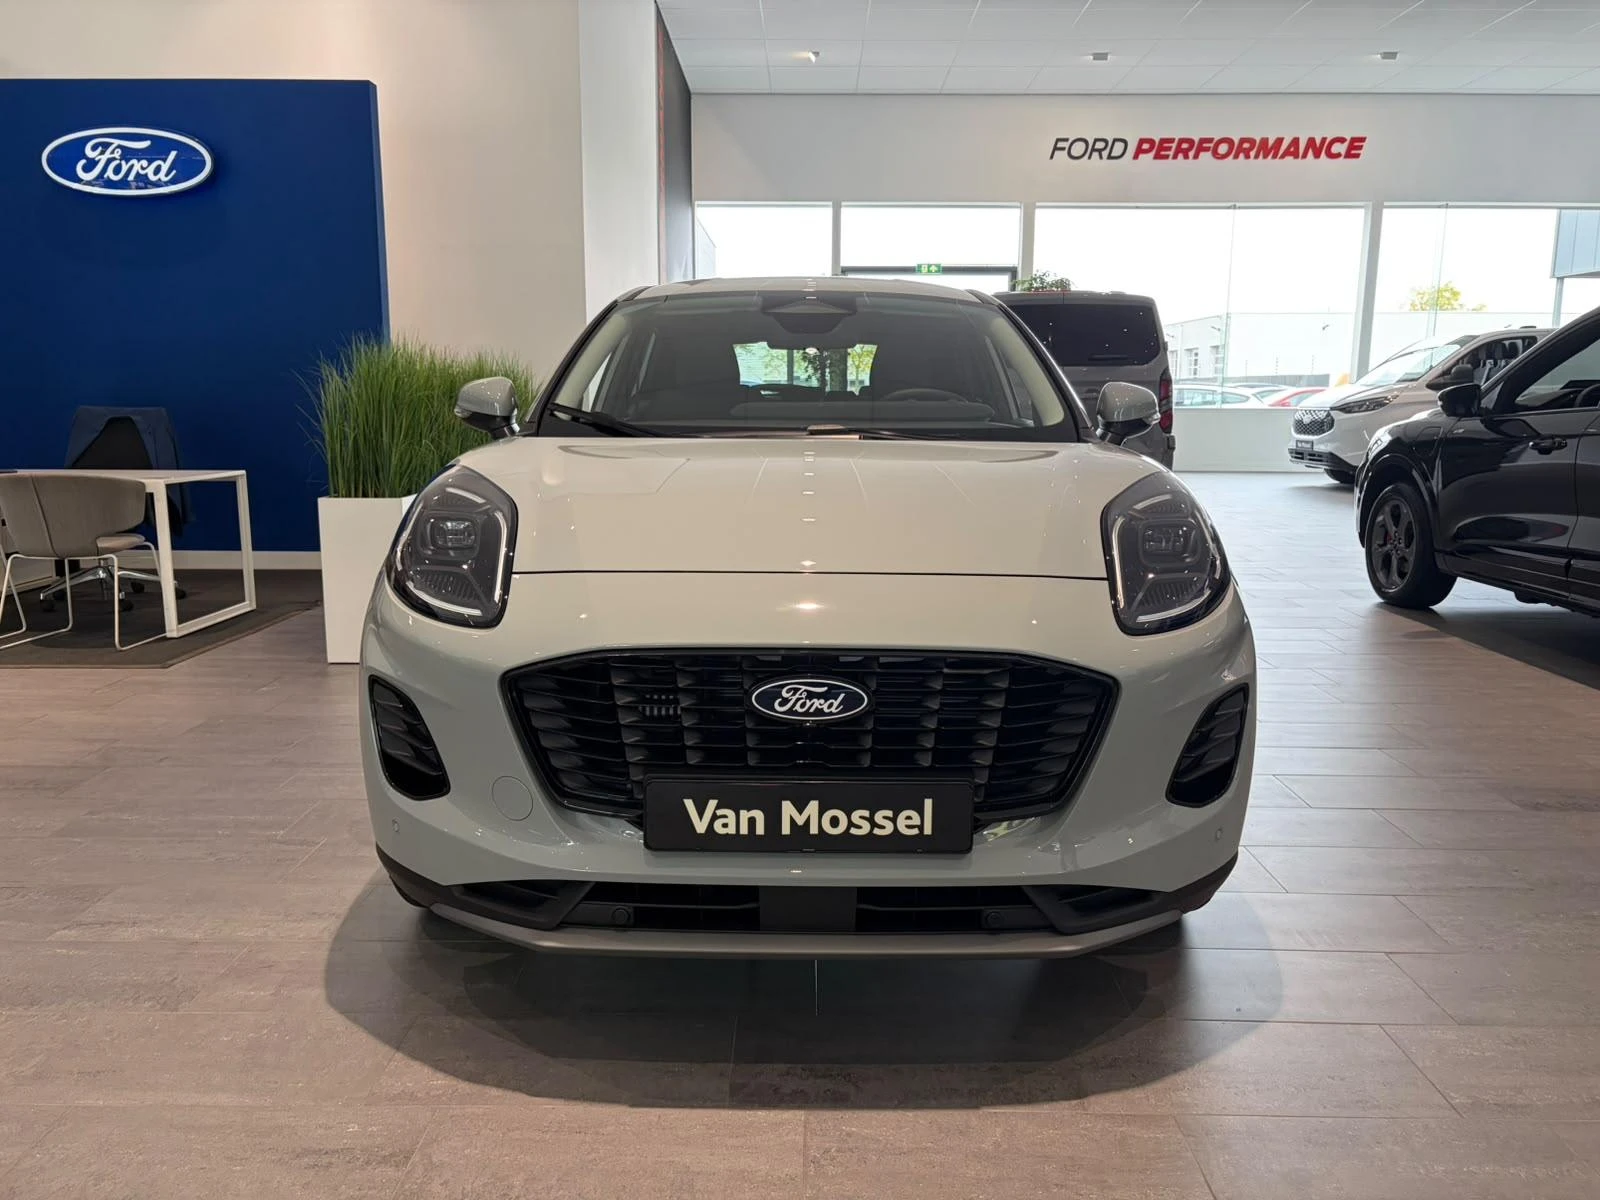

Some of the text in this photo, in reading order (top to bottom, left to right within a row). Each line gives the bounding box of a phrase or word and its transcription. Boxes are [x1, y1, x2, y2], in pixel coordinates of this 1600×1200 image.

[76, 138, 177, 181] Ford
[1049, 136, 1367, 160] FORD PERFORMANCE
[774, 685, 845, 713] Ford
[683, 798, 933, 835] Van Mossel
